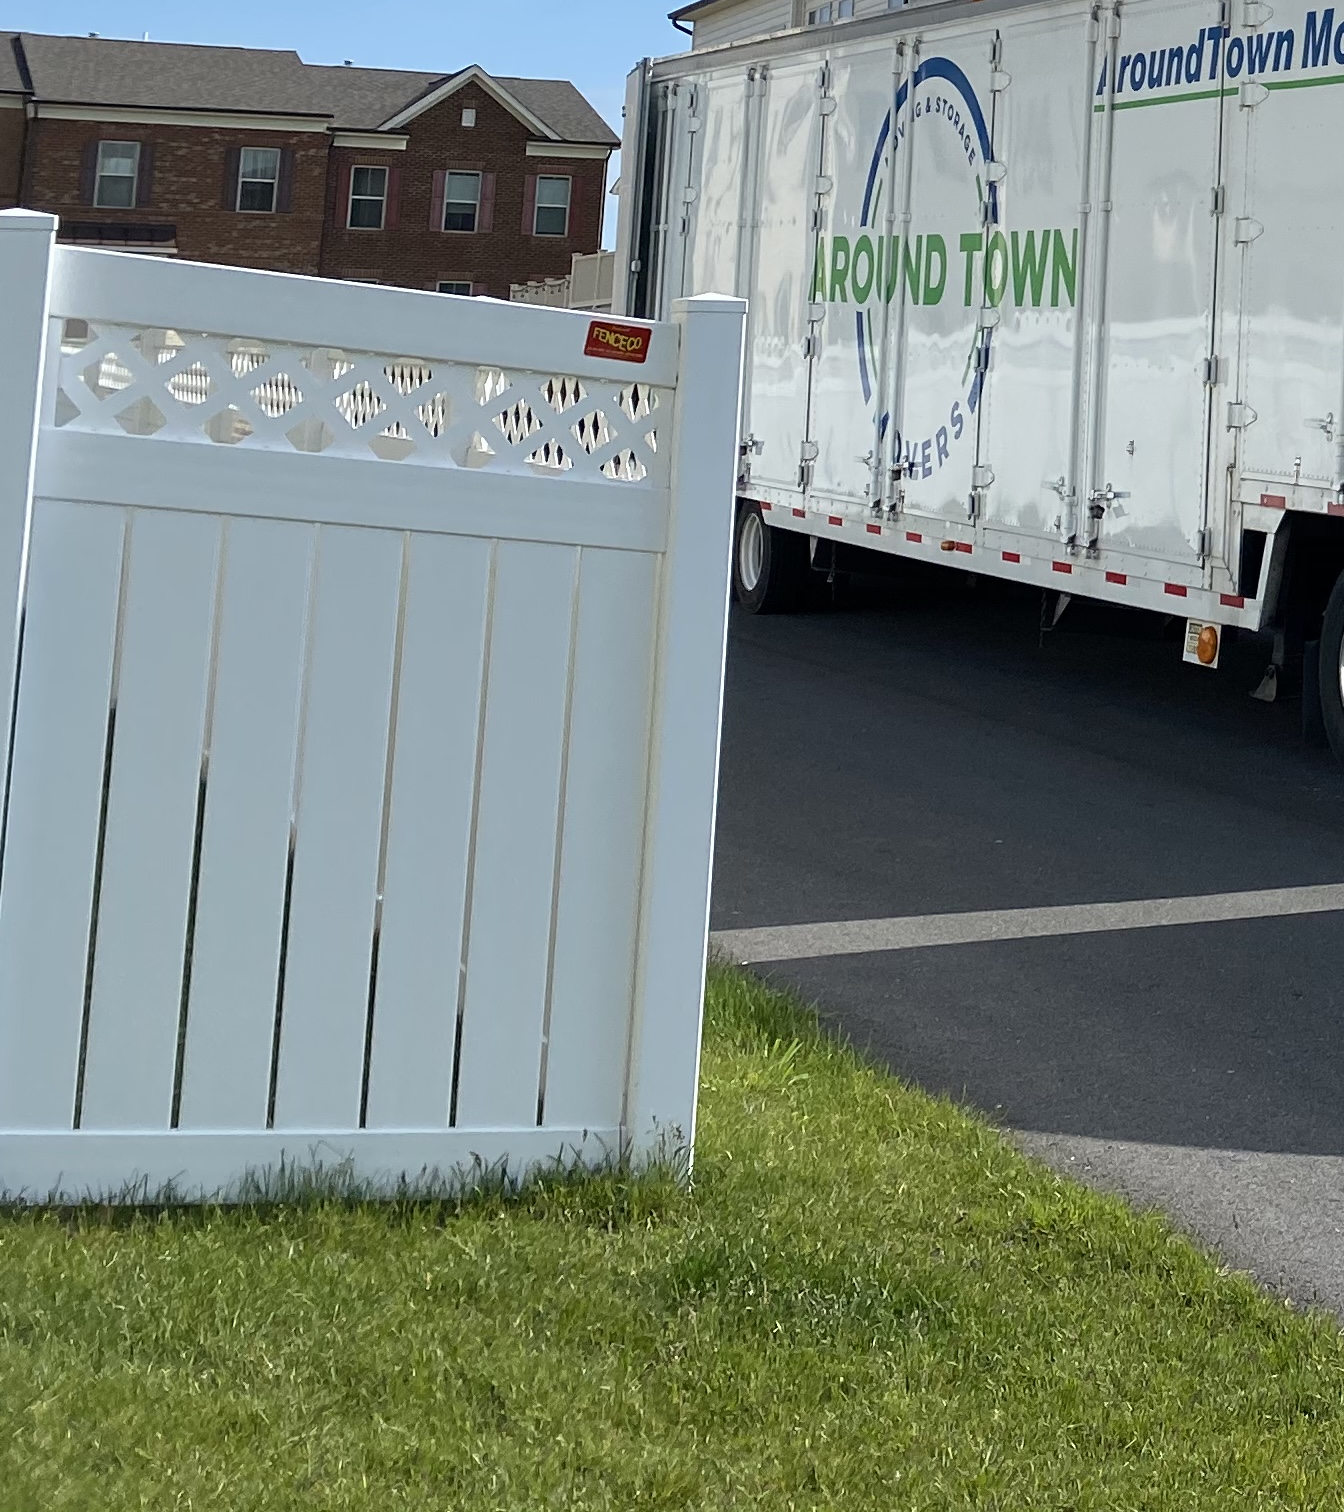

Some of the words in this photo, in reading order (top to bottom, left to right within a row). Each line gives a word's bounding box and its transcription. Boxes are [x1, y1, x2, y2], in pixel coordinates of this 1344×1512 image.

[935, 95, 977, 167] STORAGE
[807, 233, 948, 305] AROUND
[959, 227, 1079, 307] TOWN
[594, 327, 642, 351] FENCECO
